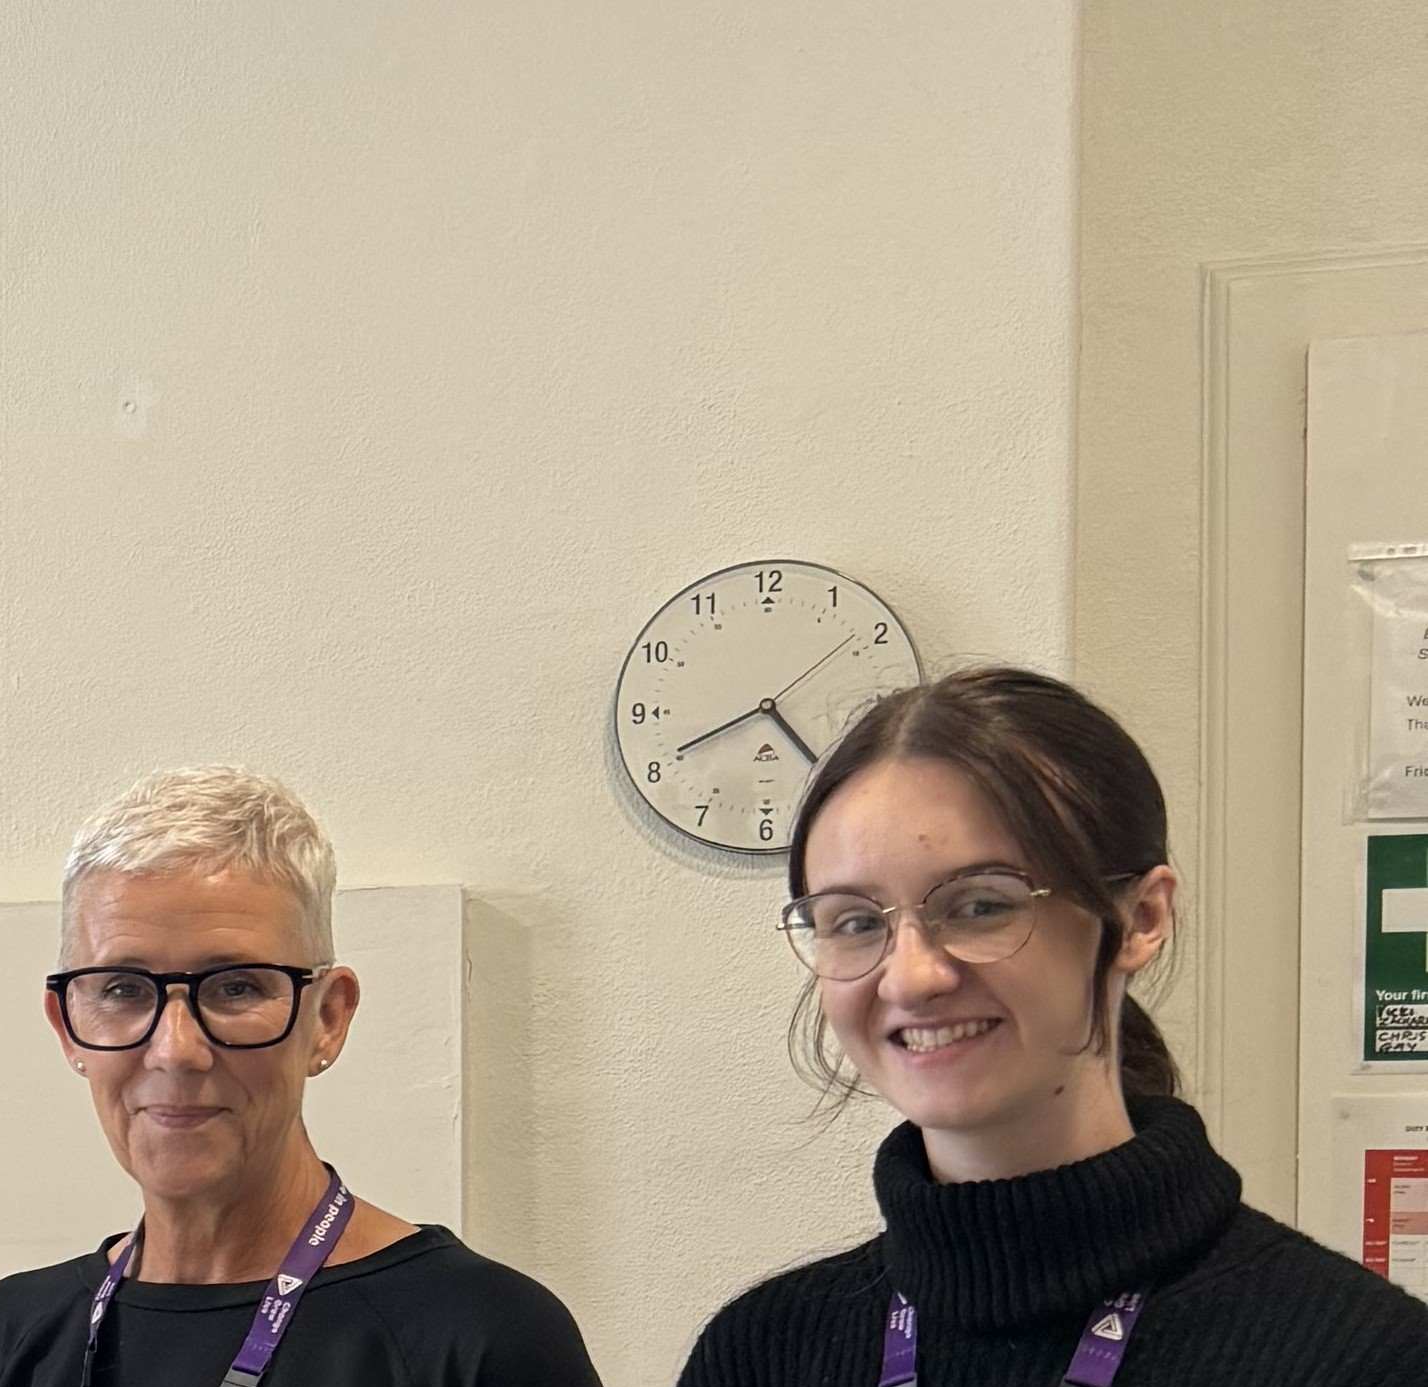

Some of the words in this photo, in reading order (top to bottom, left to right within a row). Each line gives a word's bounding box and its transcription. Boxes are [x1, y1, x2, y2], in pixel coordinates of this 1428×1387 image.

[754, 570, 783, 593] 12
[691, 592, 716, 615] 11
[827, 586, 837, 607] 1
[873, 622, 889, 645] 2
[641, 640, 668, 664] 10
[631, 702, 645, 725] 9
[647, 761, 661, 784] 8
[694, 804, 709, 827] 7
[759, 818, 773, 841] 6
[1376, 989, 1407, 1001] Your
